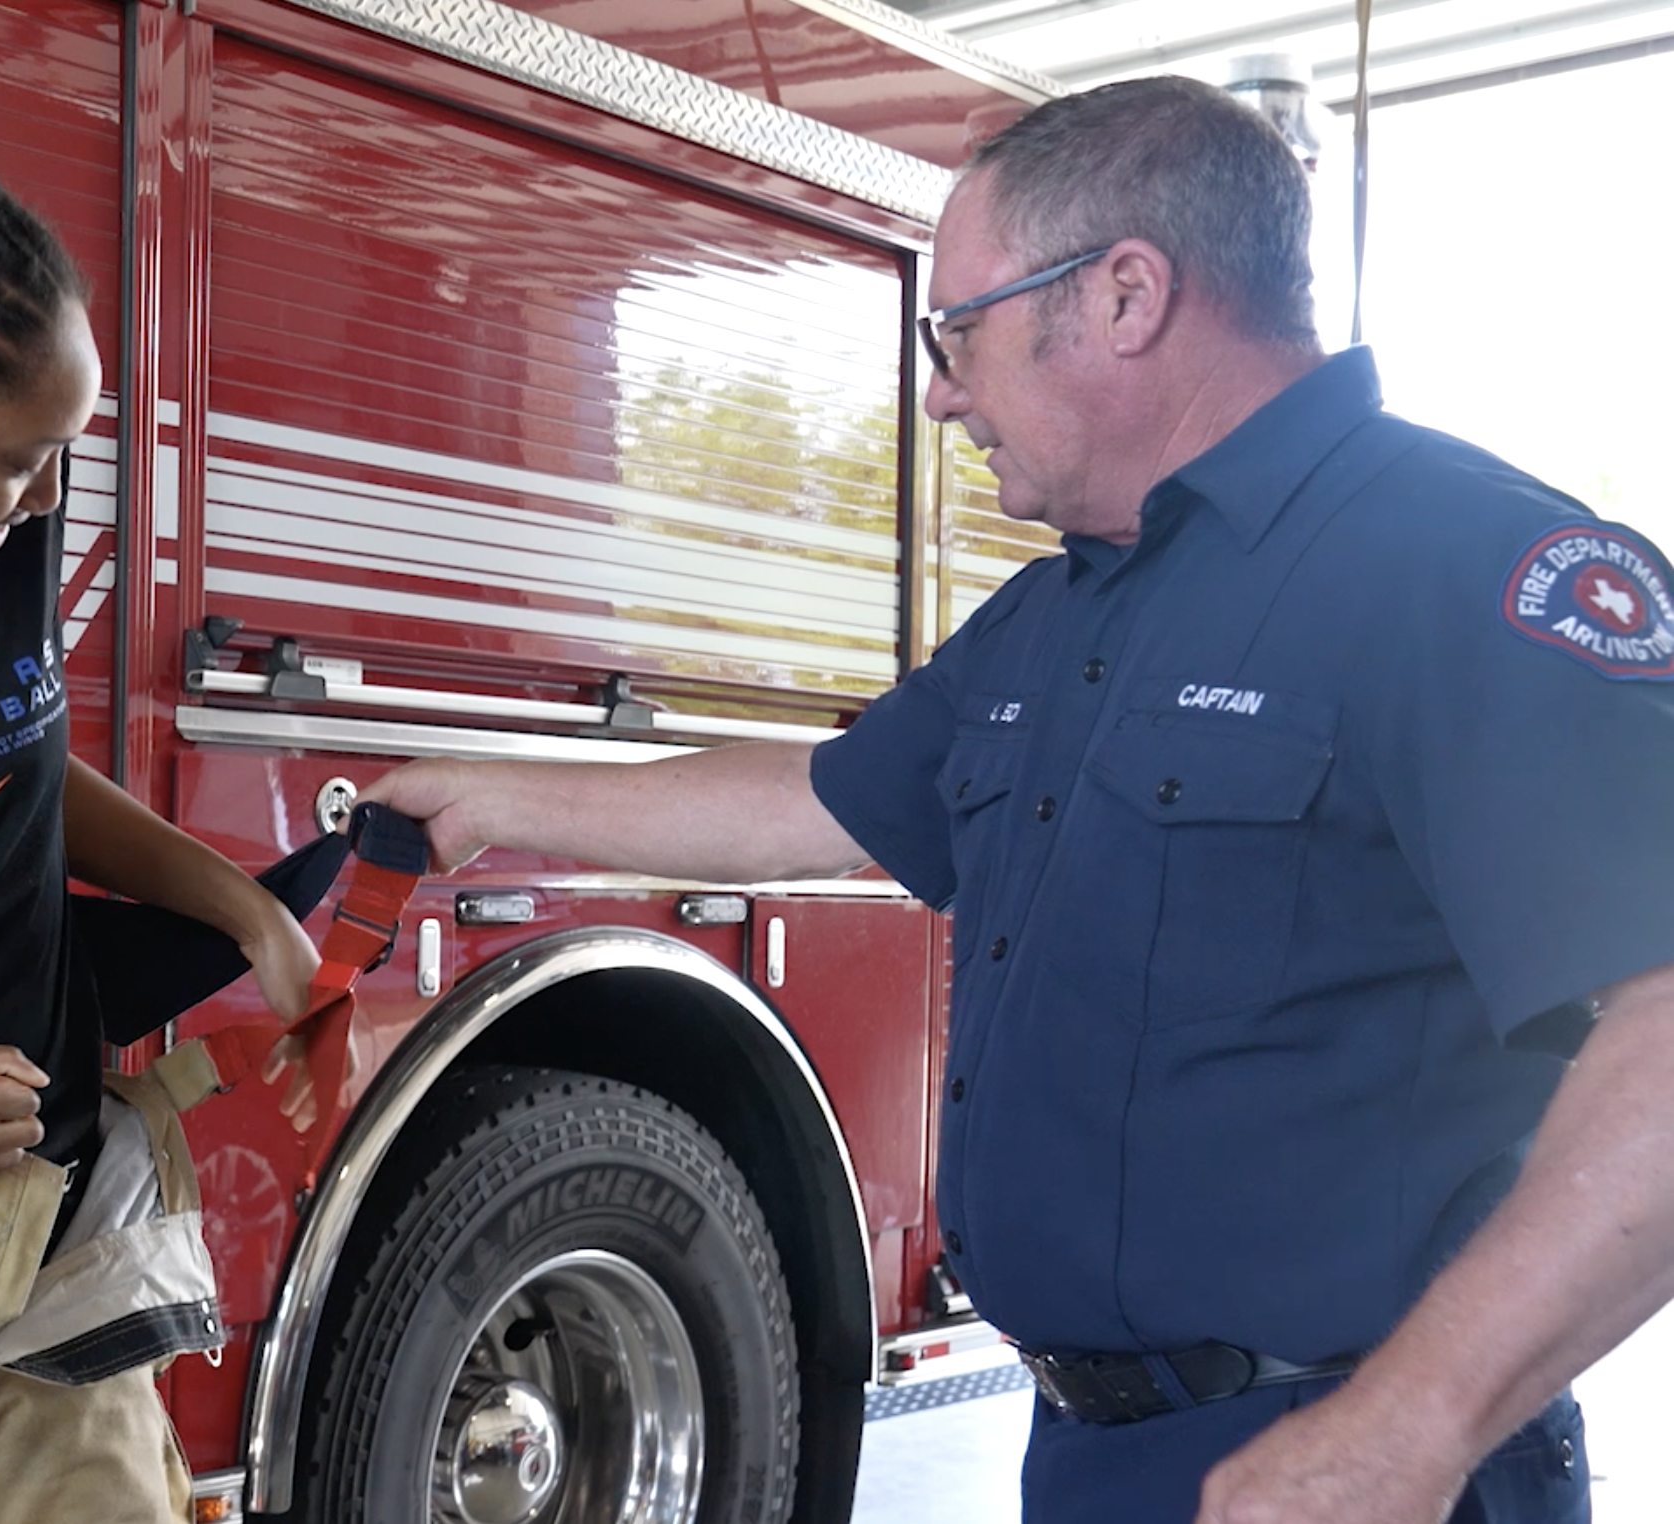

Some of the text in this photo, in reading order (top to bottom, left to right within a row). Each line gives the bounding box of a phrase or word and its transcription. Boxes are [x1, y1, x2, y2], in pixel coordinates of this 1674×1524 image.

[1517, 563, 1559, 617] FIRE
[1177, 684, 1265, 716] CAPTAIN
[12, 728, 45, 750] WINGS
[506, 1167, 703, 1247] MICHELIN
